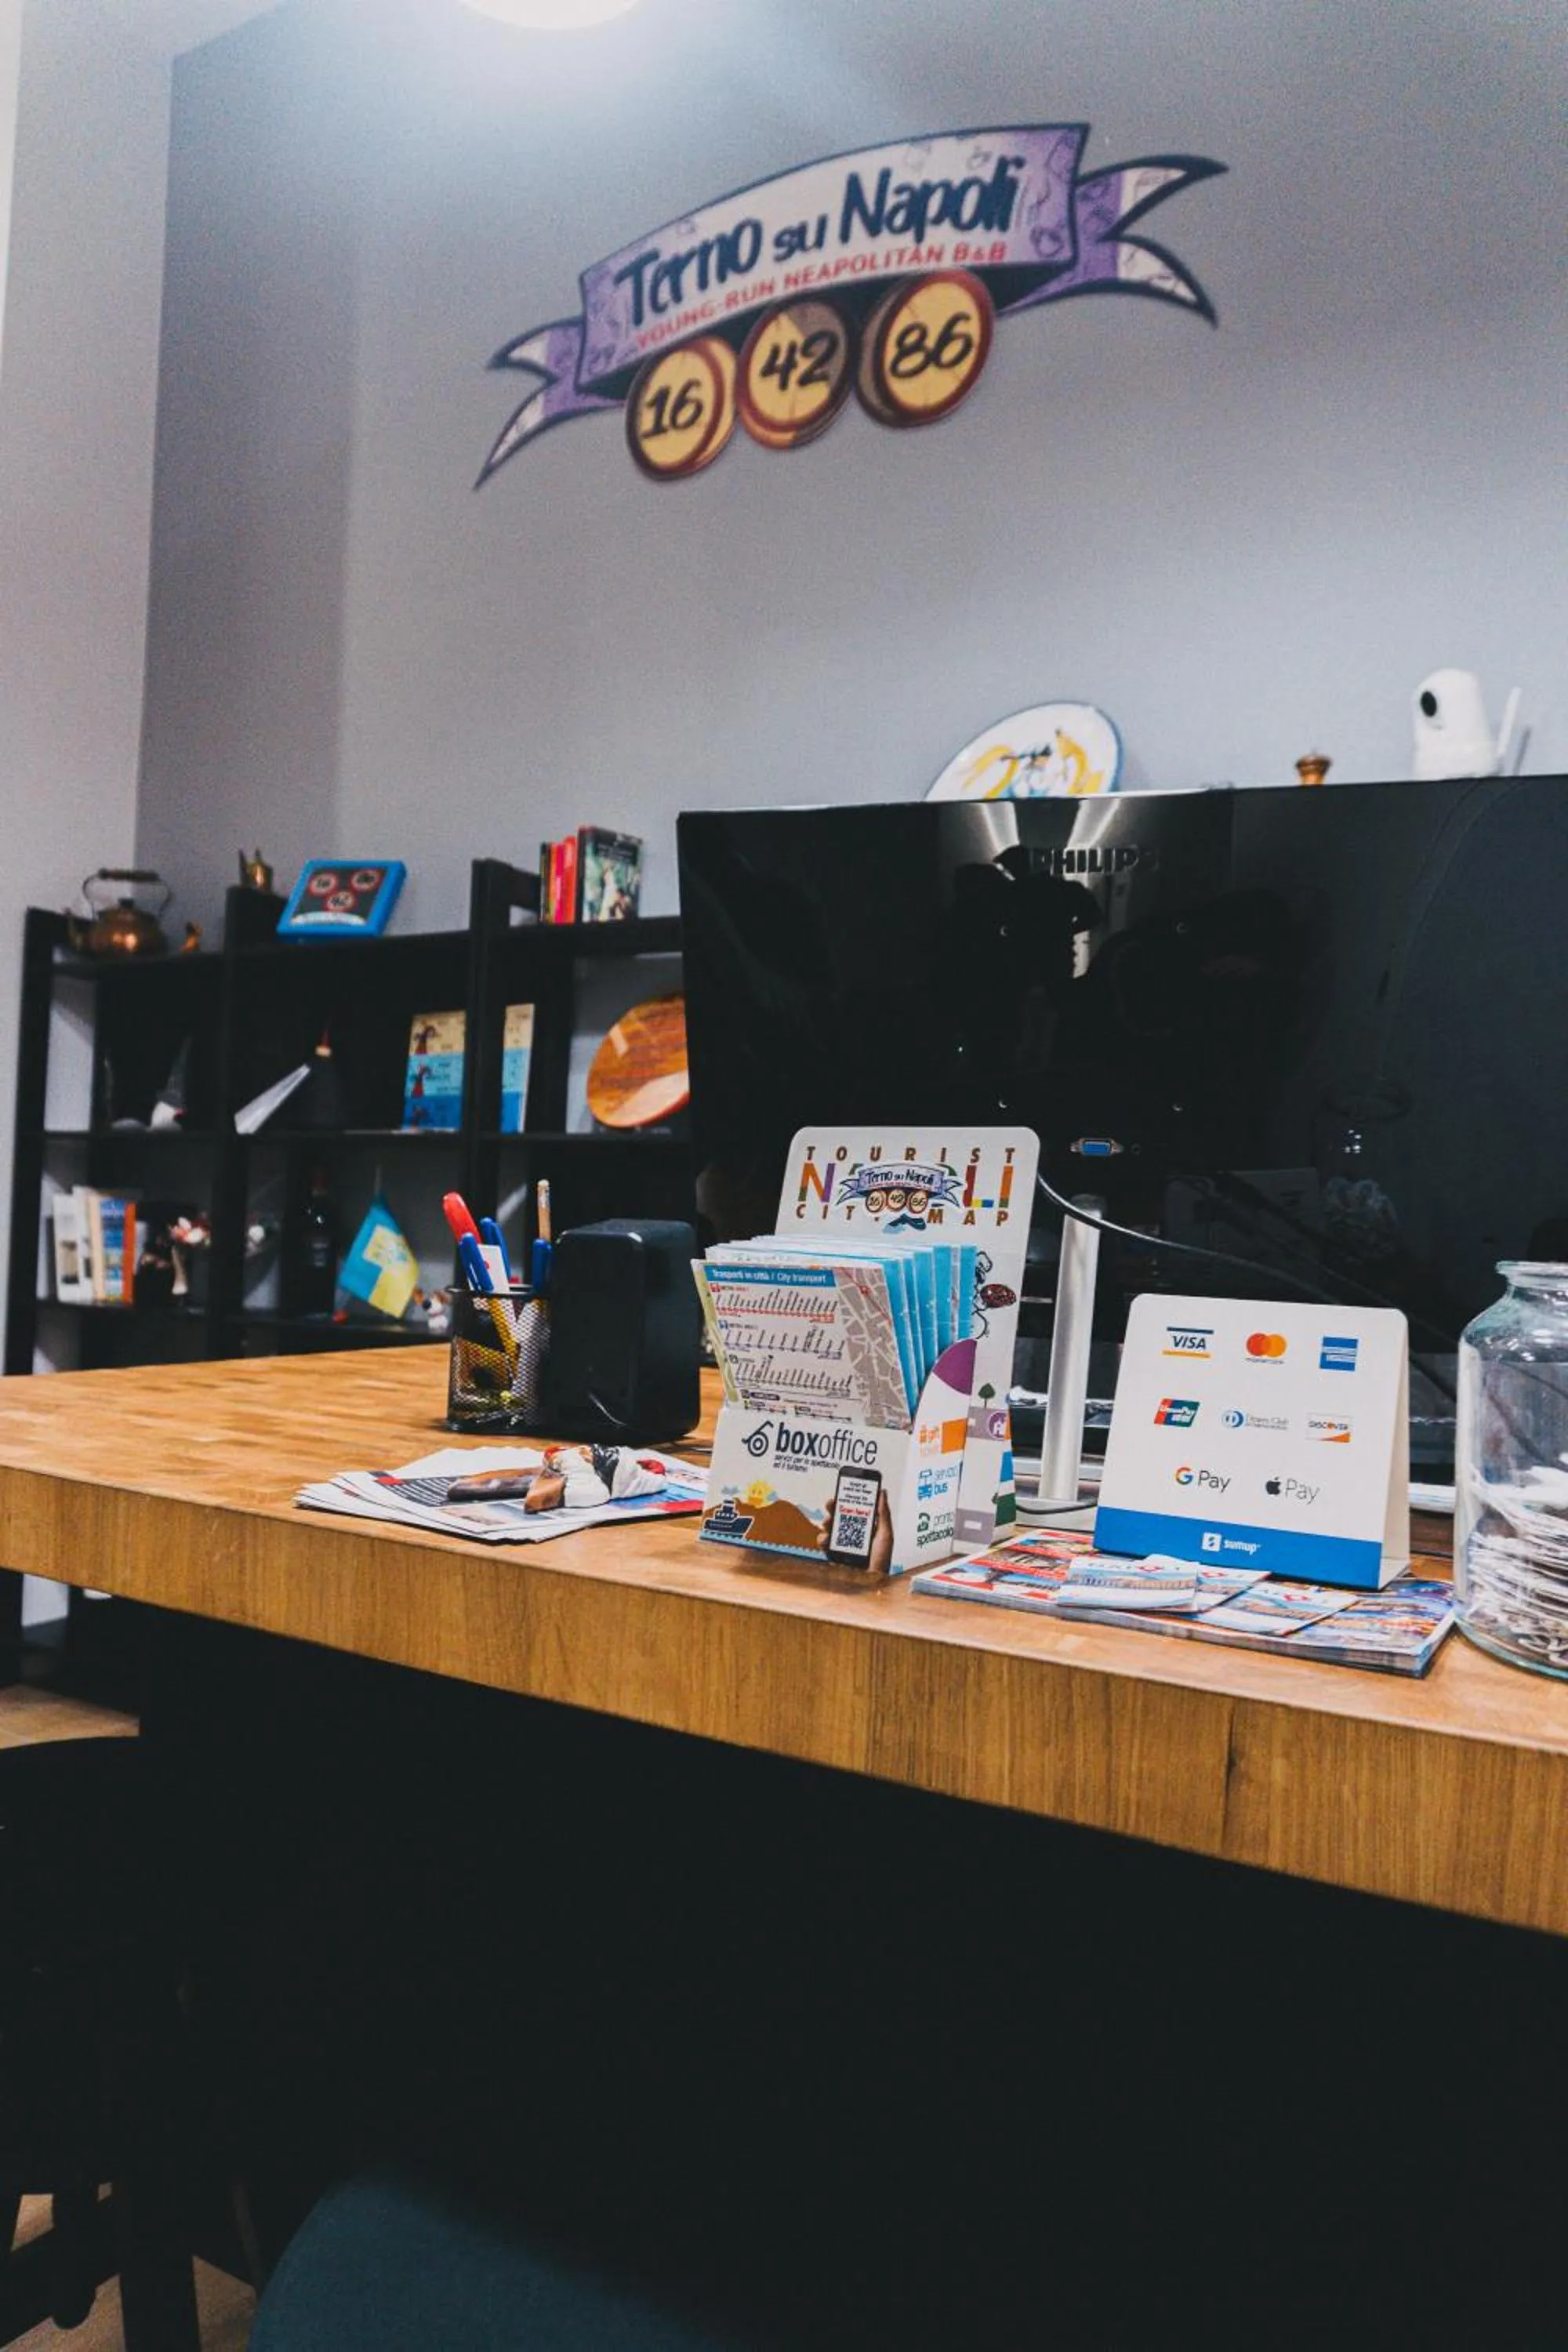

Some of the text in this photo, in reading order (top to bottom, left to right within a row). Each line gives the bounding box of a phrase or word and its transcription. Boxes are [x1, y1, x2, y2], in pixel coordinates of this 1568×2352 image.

[773, 213, 828, 262] su
[839, 154, 1025, 245] Napoli
[784, 244, 944, 289] NEAPOLITAN
[759, 329, 838, 391] 42
[888, 311, 973, 379] 86
[641, 379, 704, 439] 16
[806, 1146, 1015, 1163] TOURIST
[796, 1204, 1009, 1226] CIT MAP
[1172, 1334, 1207, 1349] VISA
[775, 1421, 878, 1465] boxoffice
[1197, 1470, 1232, 1494] Pay
[1285, 1478, 1320, 1505] Pay
